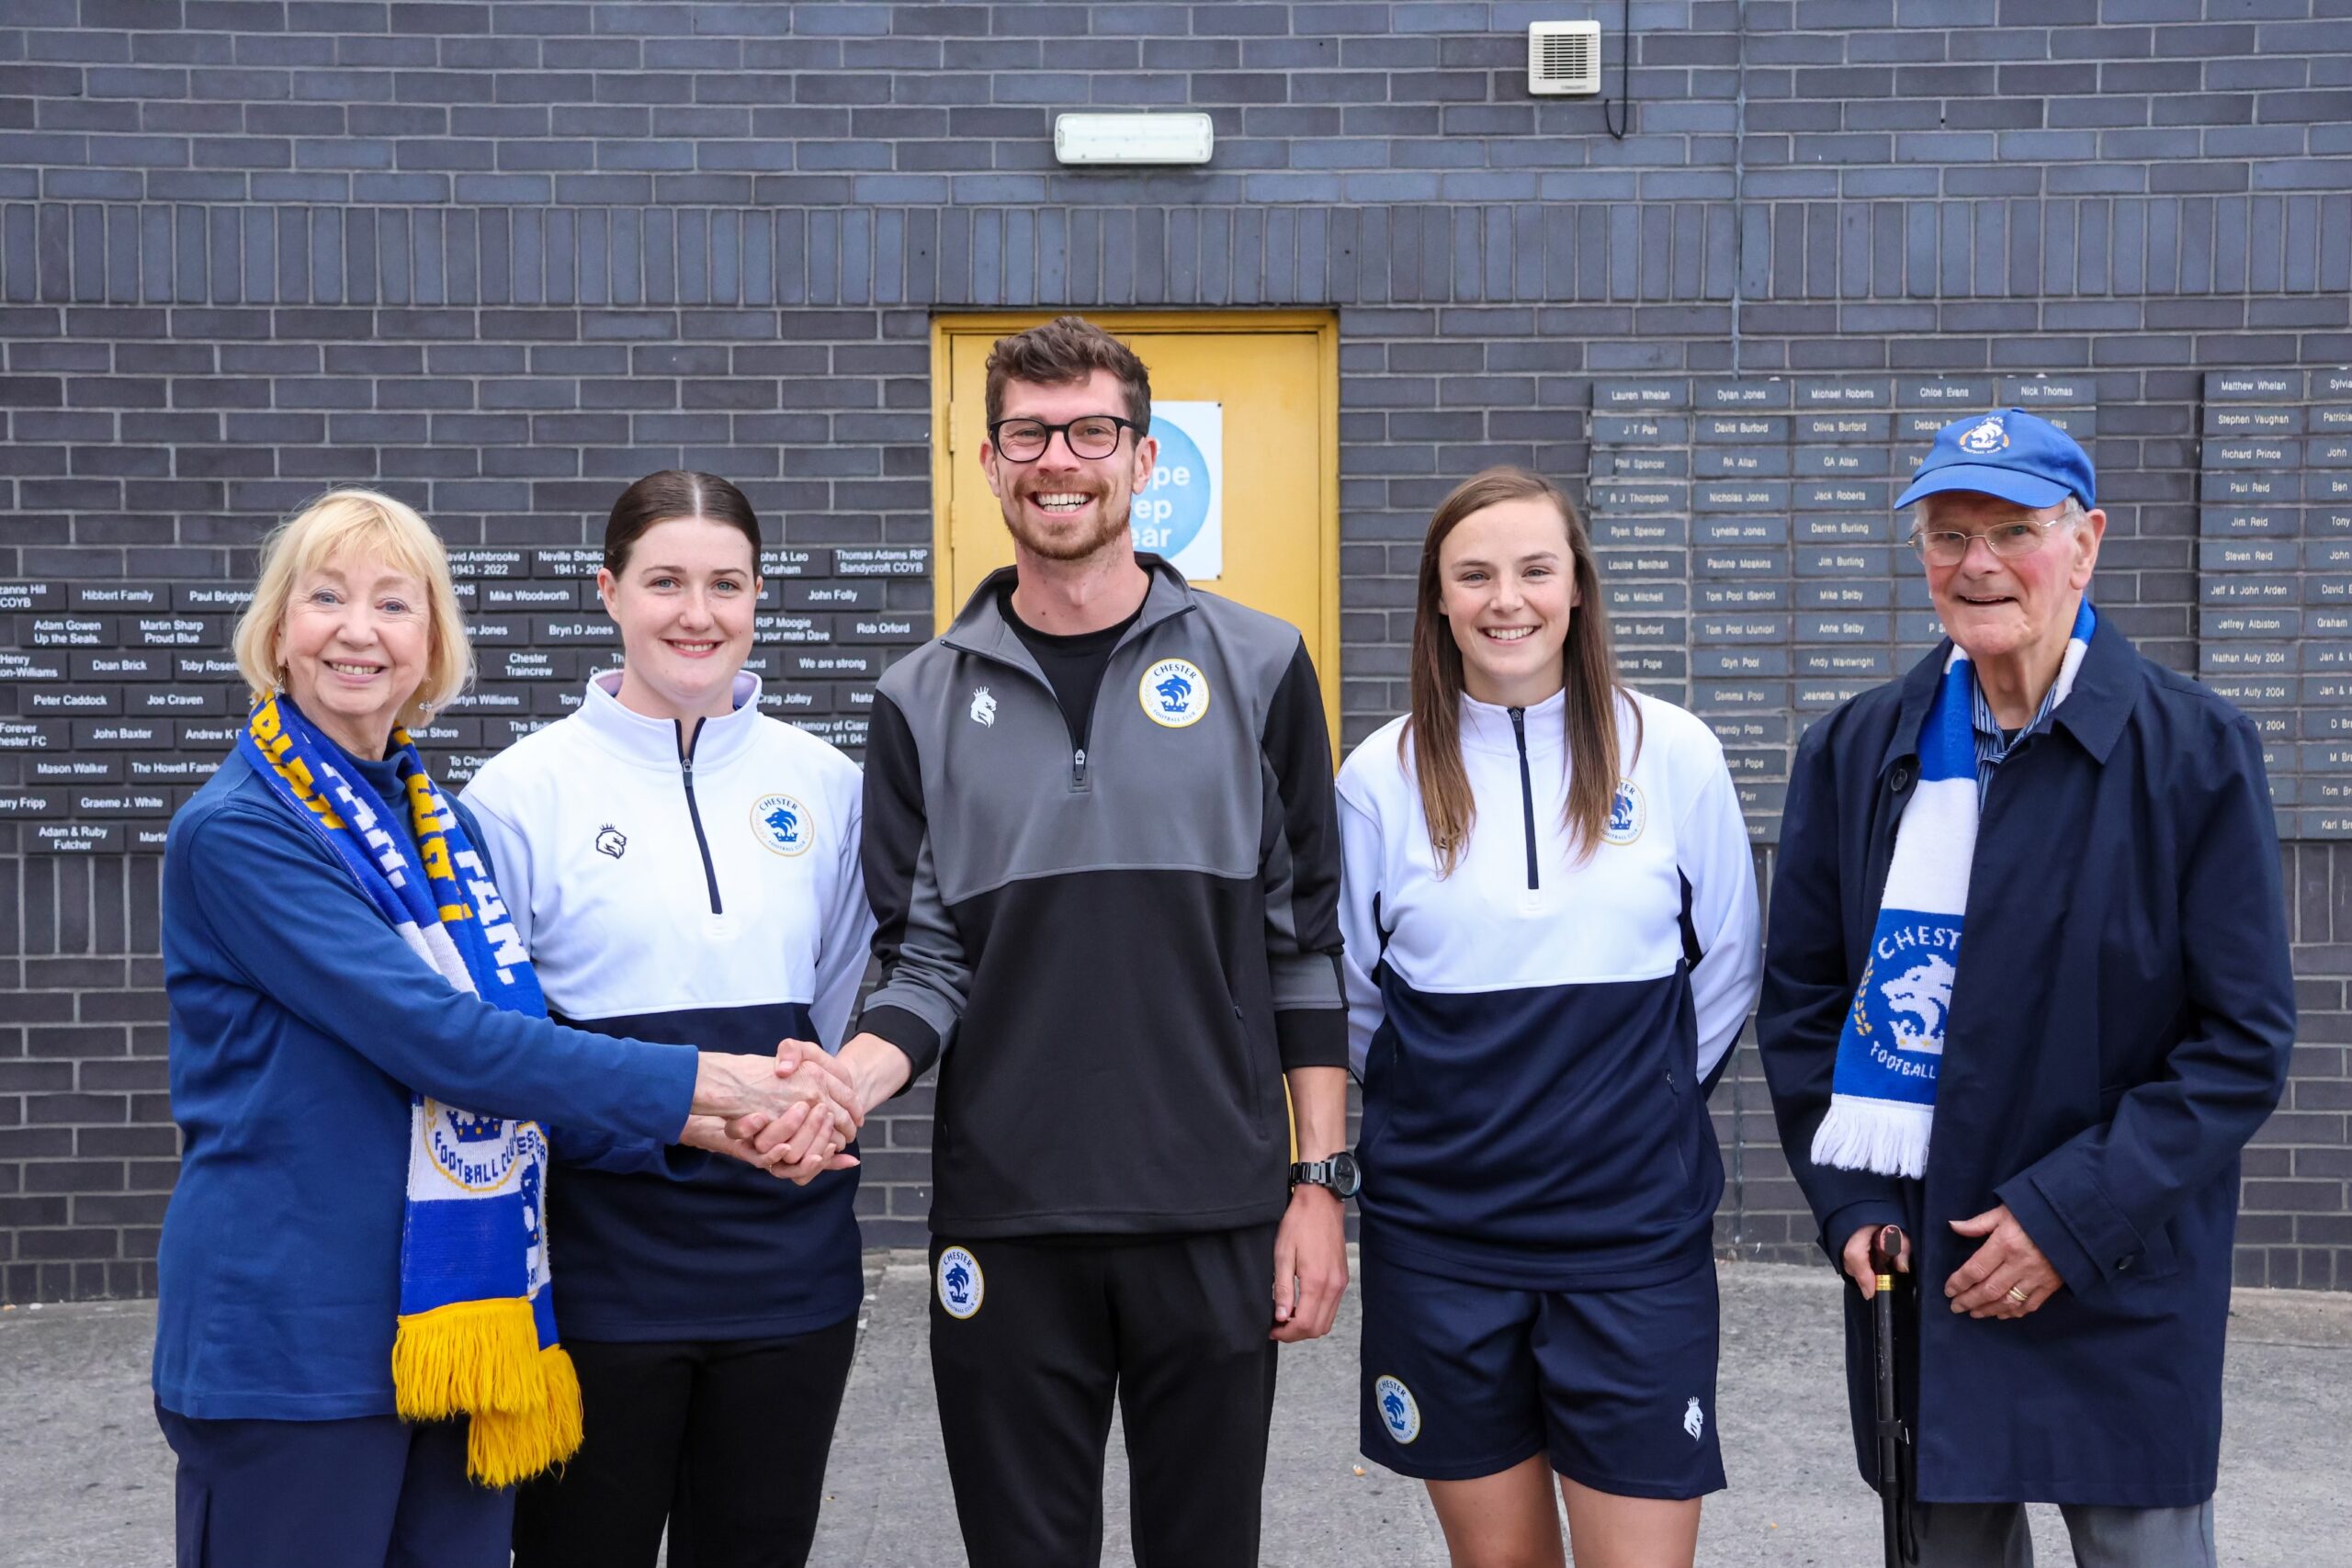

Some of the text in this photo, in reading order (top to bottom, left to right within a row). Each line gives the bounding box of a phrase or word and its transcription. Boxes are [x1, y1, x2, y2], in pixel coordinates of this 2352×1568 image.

[2222, 381, 2286, 390] Matthew Whelan
[1611, 390, 1670, 400] Lauren Whelan
[1718, 389, 1766, 401] Dylan Jones
[1812, 389, 1873, 399] Michael Roberts
[1920, 388, 1968, 397] Chloe Evans
[2021, 386, 2073, 396] Nick Thomas
[2219, 414, 2289, 425] Stephen Vaughan
[1715, 423, 1768, 433] David Burford
[1814, 422, 1866, 432] Olivia Burford
[1915, 420, 1941, 430] Debbie
[2222, 449, 2280, 458] Richard Prince
[2327, 448, 2346, 457] John
[1724, 457, 1757, 468] RA Allan
[1824, 457, 1858, 467] GA Allan
[2231, 482, 2269, 492] Paul Reid
[2333, 482, 2347, 491] Ben
[1710, 493, 1769, 502] Nicholas Jones
[1815, 491, 1865, 500] Jack Roberts
[2232, 517, 2267, 526] Jim Reid
[2332, 516, 2350, 527] Tony
[1712, 527, 1766, 537] Lynette Jones
[1812, 523, 1869, 535] Darren Burling
[836, 549, 927, 559] Thomas Adams RIP
[2225, 551, 2272, 560] Steven Reid
[2330, 551, 2349, 559] John
[1818, 557, 1864, 568] Jim Burling
[451, 564, 475, 575] 1943
[484, 564, 508, 574] 2022
[763, 564, 801, 574] Graham
[840, 562, 923, 574] Sandycroft COYB
[2211, 585, 2287, 594] Jeff & John Arden
[2323, 584, 2343, 593] David
[83, 590, 153, 603] Hibbert Family
[190, 591, 212, 601] Paul
[490, 591, 569, 601] Mike Woodworth
[808, 590, 857, 602] John Folly
[1614, 592, 1629, 602] Dan
[1820, 590, 1862, 601] Mike Selby
[0, 597, 31, 607] COYB
[34, 620, 101, 630] Adam Gowen
[141, 620, 203, 634] Martin Sharp
[756, 617, 812, 630] RIP Moogie
[2219, 619, 2279, 630] Jeffrey Albiston
[2317, 618, 2347, 627] Graham
[549, 625, 614, 637] Bryn D Jones
[857, 623, 910, 633] Rob Orford
[1819, 624, 1864, 635] Anne Selby
[35, 633, 100, 645] Up the Seals.
[145, 633, 199, 643] Proud Blue
[0, 654, 30, 668] Henry
[510, 653, 547, 663] Chester
[1810, 658, 1873, 668] Andy Wainwright
[2212, 653, 2284, 664] Nathan Auty 2004
[93, 660, 147, 671] Dean Brick
[799, 658, 866, 671] We are strong
[1722, 658, 1758, 669] Glyn Pool
[505, 666, 552, 676] Traincrew
[1154, 663, 1197, 679] CHESTER
[34, 694, 107, 705] Peter Caddock
[147, 694, 203, 705] Joe Craven
[94, 728, 152, 739] John Baxter
[430, 728, 458, 738] Shore
[31, 736, 46, 746] FC
[38, 763, 107, 773] Mason Walker
[20, 797, 46, 809] Fripp
[81, 797, 163, 807] Graeme J. White
[759, 797, 798, 811] CHESTER
[39, 827, 107, 839] Adam & Ruby
[54, 840, 91, 850] Futcher
[1870, 1040, 1936, 1079] FOOTBALL
[435, 1131, 499, 1184] FOOTBALL
[944, 1251, 973, 1268] CHESTER
[1379, 1380, 1407, 1397] CHESTER
